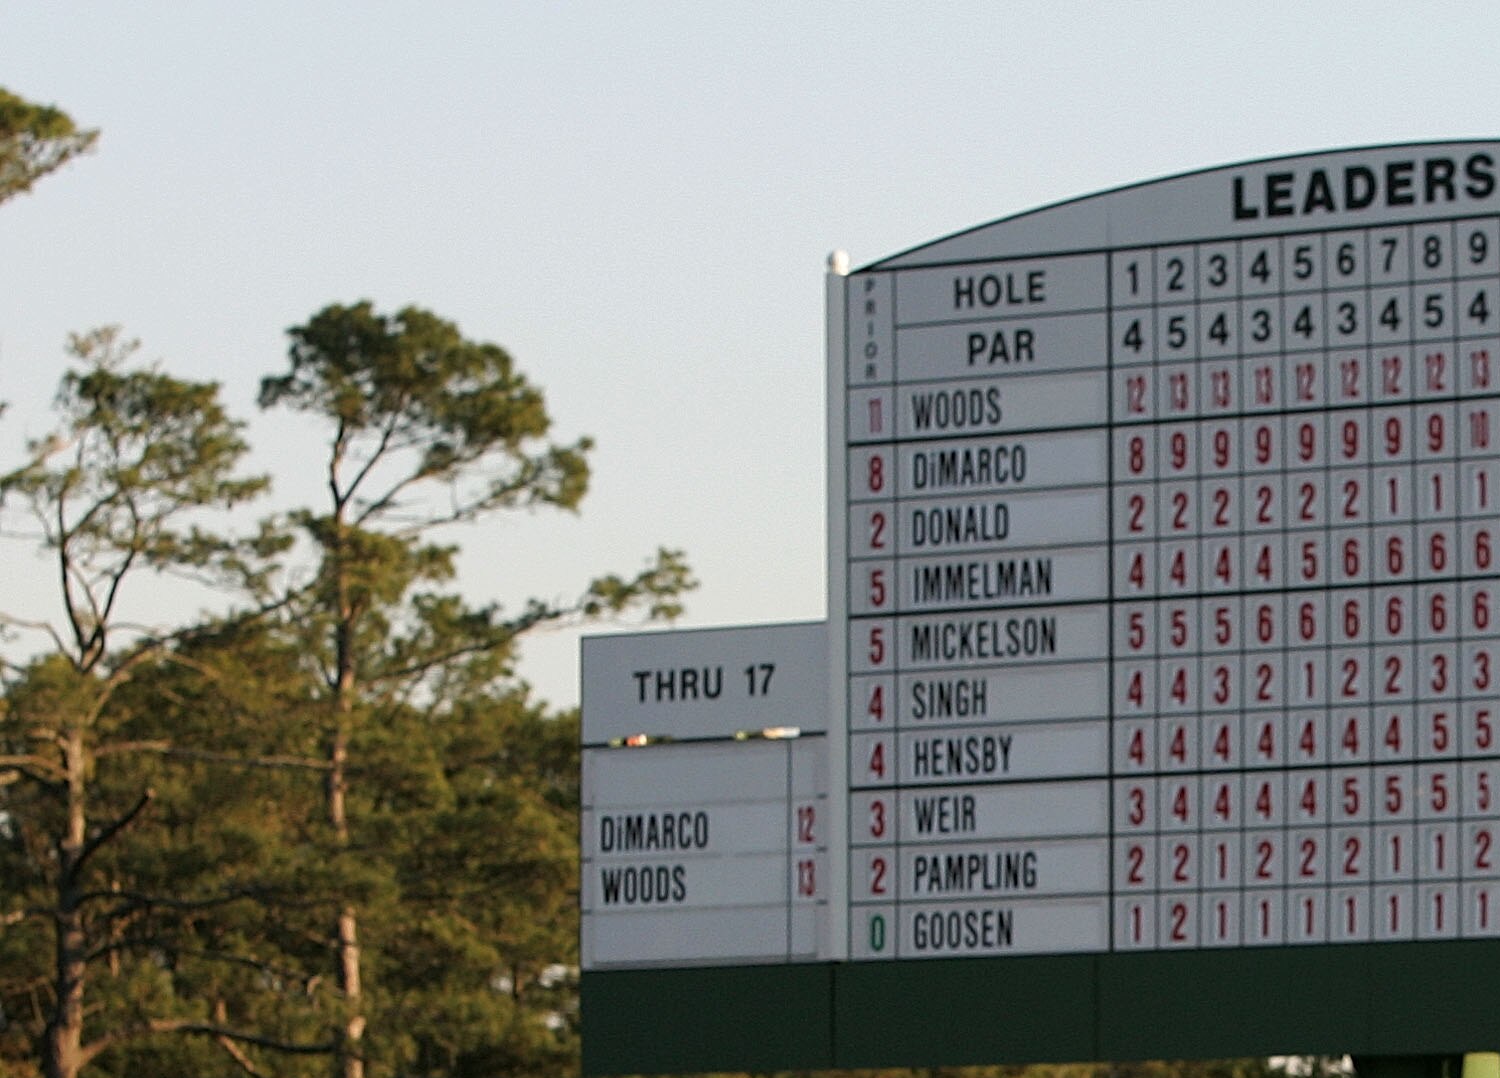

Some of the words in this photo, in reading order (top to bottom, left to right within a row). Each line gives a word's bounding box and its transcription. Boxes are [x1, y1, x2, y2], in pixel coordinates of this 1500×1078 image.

[1233, 153, 1498, 222] LEADERS
[954, 271, 1047, 310] HOLE
[1127, 262, 1139, 295] 1
[1167, 258, 1185, 292] 2
[1208, 254, 1228, 288] 3
[1249, 250, 1271, 284] 4
[1293, 245, 1314, 280] 5
[1336, 243, 1356, 276] 6
[1381, 237, 1398, 273] 7
[1423, 235, 1442, 269] 8
[1468, 231, 1488, 265] 9
[968, 329, 1036, 366] PAR
[1122, 319, 1144, 353] 4
[1167, 315, 1187, 349] 5
[1208, 312, 1229, 346] 4
[1252, 309, 1272, 343] 3
[1293, 305, 1315, 339] 4
[1338, 301, 1358, 335] 3
[1379, 297, 1401, 332] 4
[1424, 293, 1444, 329] 5
[1468, 290, 1490, 324] 4
[911, 388, 1002, 430] WOODS
[868, 454, 884, 493] 8
[913, 445, 1027, 490] DiMARCO
[1129, 436, 1145, 475] 8
[1170, 431, 1188, 471] 9
[1213, 430, 1231, 469] 9
[1255, 425, 1272, 465] 9
[1298, 423, 1316, 462] 9
[1342, 420, 1359, 459] 9
[1384, 417, 1402, 456] 9
[1427, 413, 1445, 453] 9
[869, 511, 886, 550] 2
[912, 504, 1010, 547] DONALD
[870, 569, 886, 608] 5
[913, 559, 1053, 603] IMMELMAN
[1128, 552, 1146, 590] 4
[1169, 550, 1187, 587] 4
[1215, 546, 1232, 584] 4
[1255, 545, 1273, 582] 4
[1302, 540, 1318, 581] 5
[1342, 538, 1360, 577] 6
[1386, 536, 1404, 575] 6
[1429, 532, 1447, 572] 6
[1474, 530, 1491, 570] 6
[868, 627, 885, 666] 5
[911, 617, 1057, 661] MICKELSON
[1128, 611, 1145, 651] 5
[1171, 609, 1188, 648] 5
[1215, 607, 1232, 646] 5
[1256, 604, 1274, 644] 6
[1298, 602, 1316, 641] 6
[1343, 599, 1360, 639] 6
[1386, 596, 1403, 636] 6
[1429, 593, 1447, 633] 6
[1472, 590, 1490, 631] 6
[633, 667, 723, 703] THRU
[743, 663, 778, 699] 17
[867, 685, 885, 722] 4
[912, 680, 988, 720] SINGH
[868, 741, 887, 780] 4
[913, 735, 1013, 777] HENSBY
[1128, 728, 1145, 766] 4
[1169, 725, 1187, 763] 4
[1213, 724, 1231, 762] 4
[1257, 721, 1275, 759] 4
[1299, 719, 1316, 757] 4
[1341, 717, 1360, 755] 4
[1384, 715, 1402, 753] 4
[1432, 712, 1449, 752] 5
[1475, 710, 1492, 750] 5
[601, 812, 710, 854] DiMARCO
[797, 805, 817, 846] 12
[870, 799, 886, 839] 3
[914, 795, 977, 834] WEIR
[1128, 787, 1146, 827] 3
[1172, 785, 1189, 822] 4
[1214, 783, 1231, 821] 4
[1255, 782, 1273, 819] 4
[1299, 778, 1317, 817] 4
[1343, 777, 1360, 816] 5
[1385, 775, 1403, 815] 5
[1431, 773, 1448, 813] 5
[1477, 771, 1490, 811] 5
[602, 865, 688, 905] WOODS
[797, 859, 818, 898] 13
[870, 857, 887, 896] 2
[913, 852, 1038, 892] PAMPLING
[870, 915, 885, 951] 0
[912, 910, 1014, 949] GOOSEN
